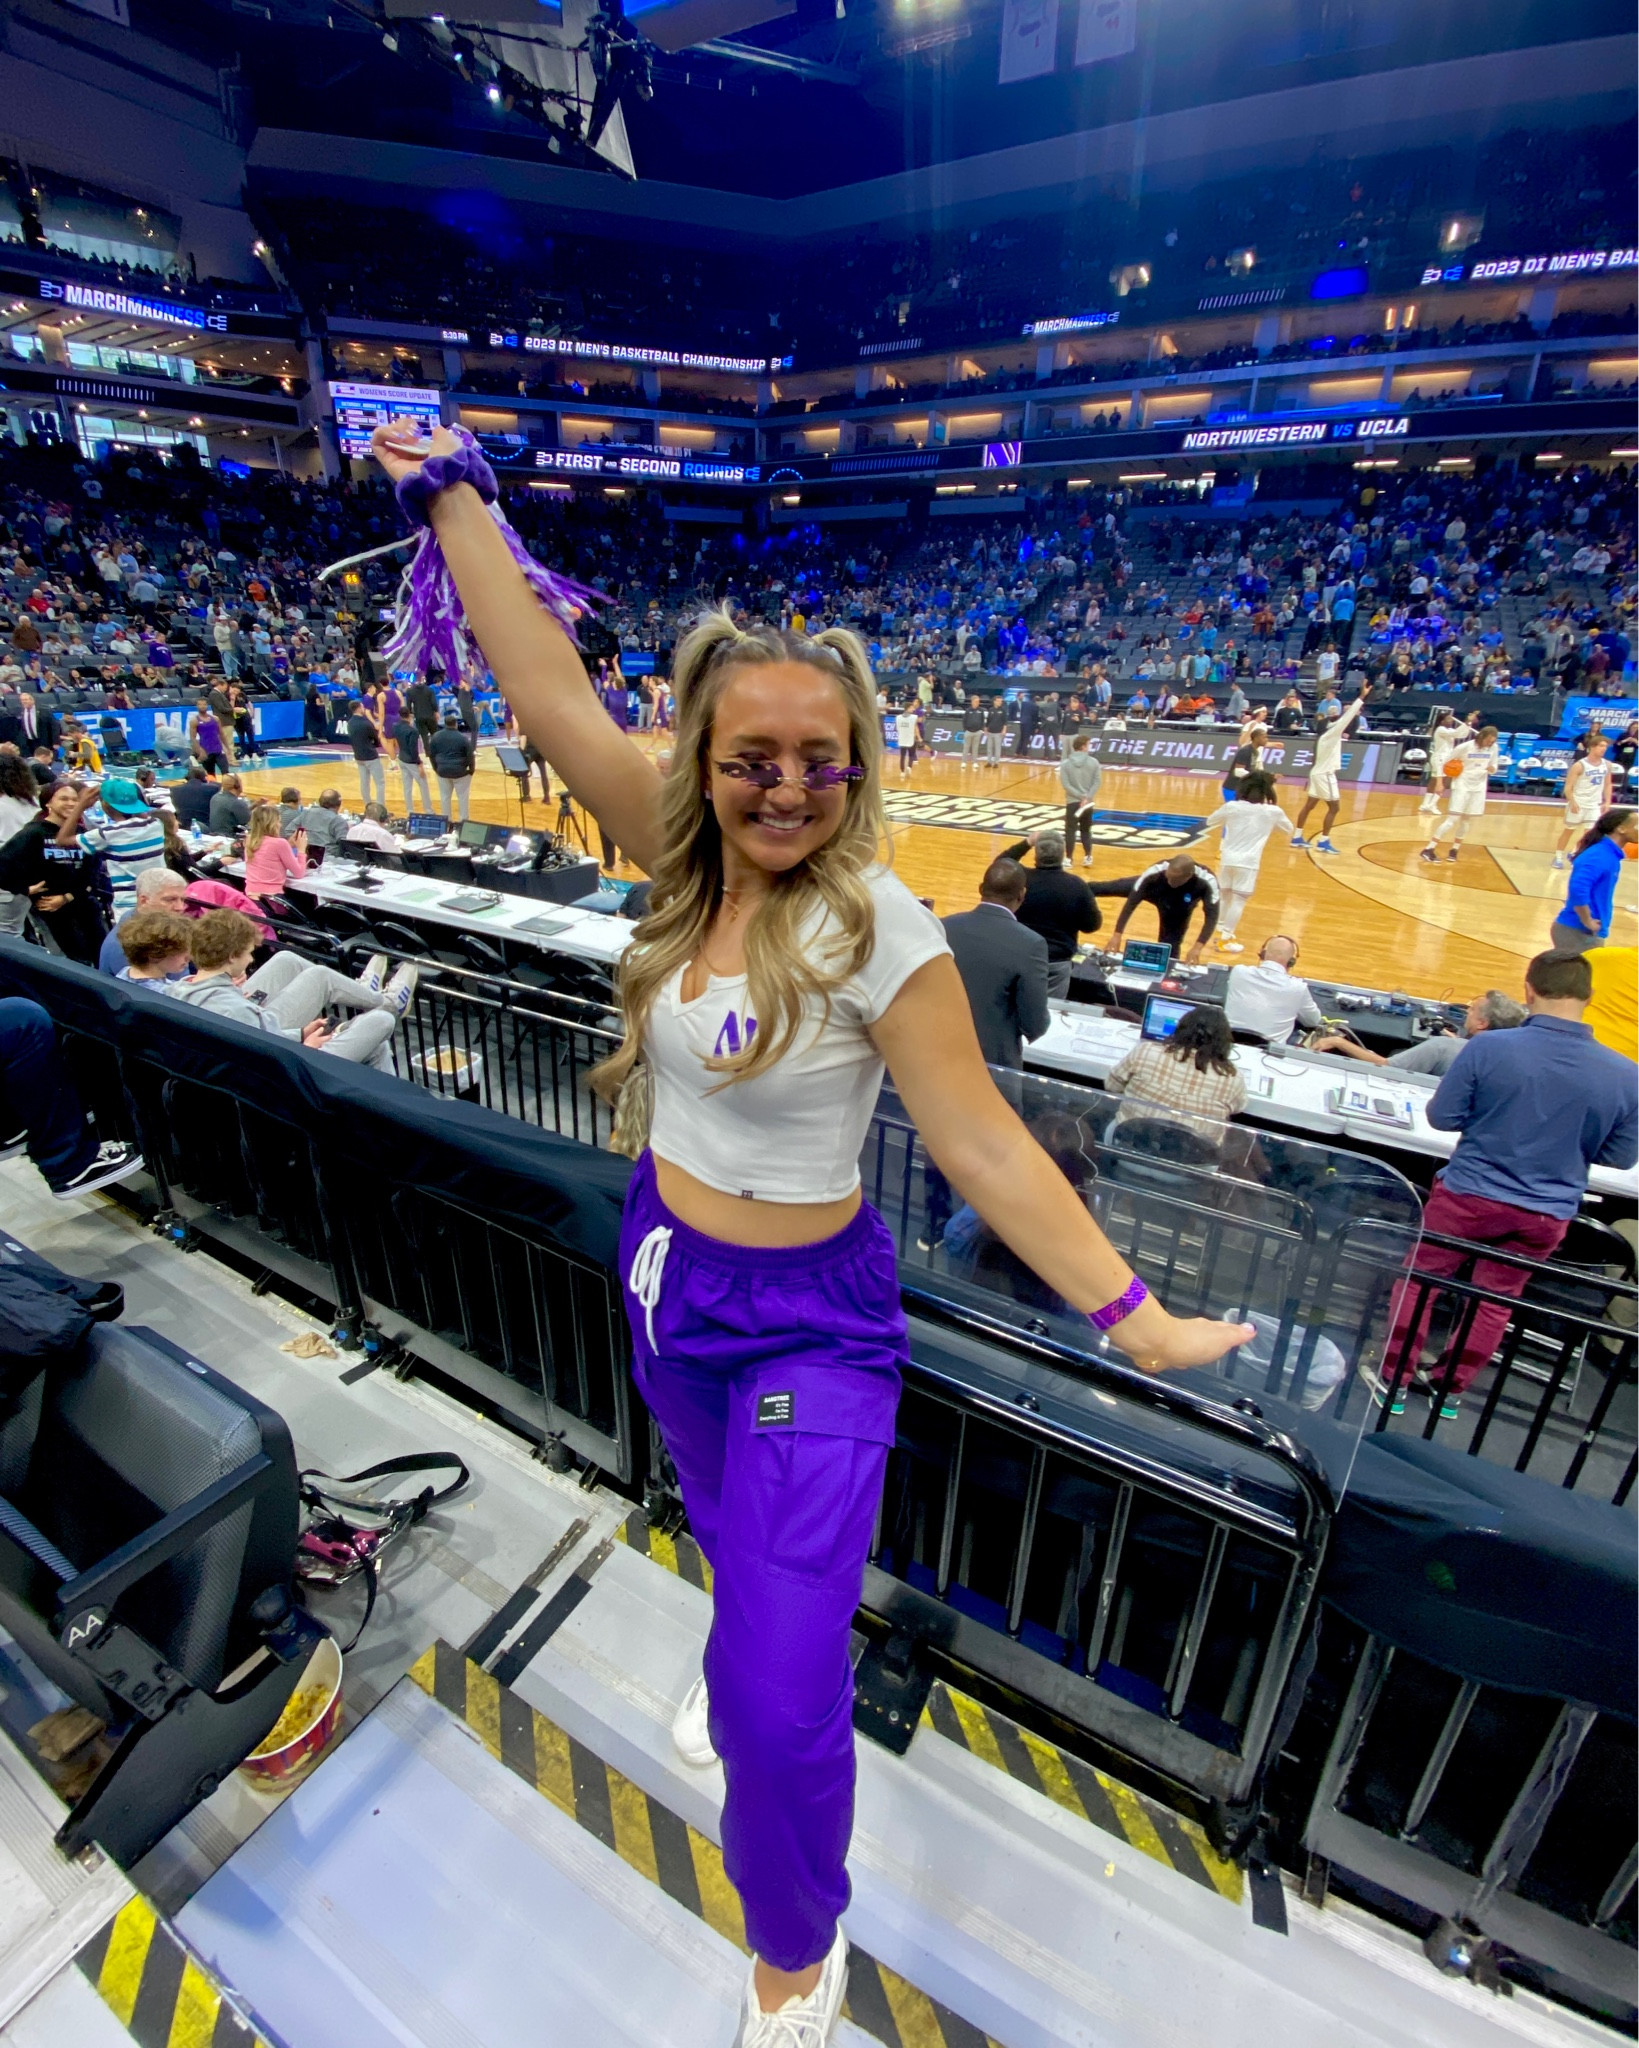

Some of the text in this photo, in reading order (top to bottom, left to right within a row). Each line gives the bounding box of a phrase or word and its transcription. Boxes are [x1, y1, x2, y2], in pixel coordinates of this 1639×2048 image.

[1470, 260, 1520, 279] 2023
[1522, 257, 1547, 274] DI
[1548, 252, 1606, 271] MEN'S
[525, 336, 766, 370] 2023 DI MEN'S BASKETBALL CHAMPIONSHIP
[359, 387, 387, 397] WOMENS
[388, 390, 408, 399] SCORE
[409, 392, 432, 400] UPDATE
[1183, 418, 1409, 448] NORTHWESTERN VS UCLA
[555, 453, 744, 479] FIRST AND SECOND ROUNDS
[1589, 708, 1630, 719] MARCH
[1107, 738, 1148, 756] THE
[1150, 741, 1216, 760] FINAL
[68, 1614, 103, 1648] AA
